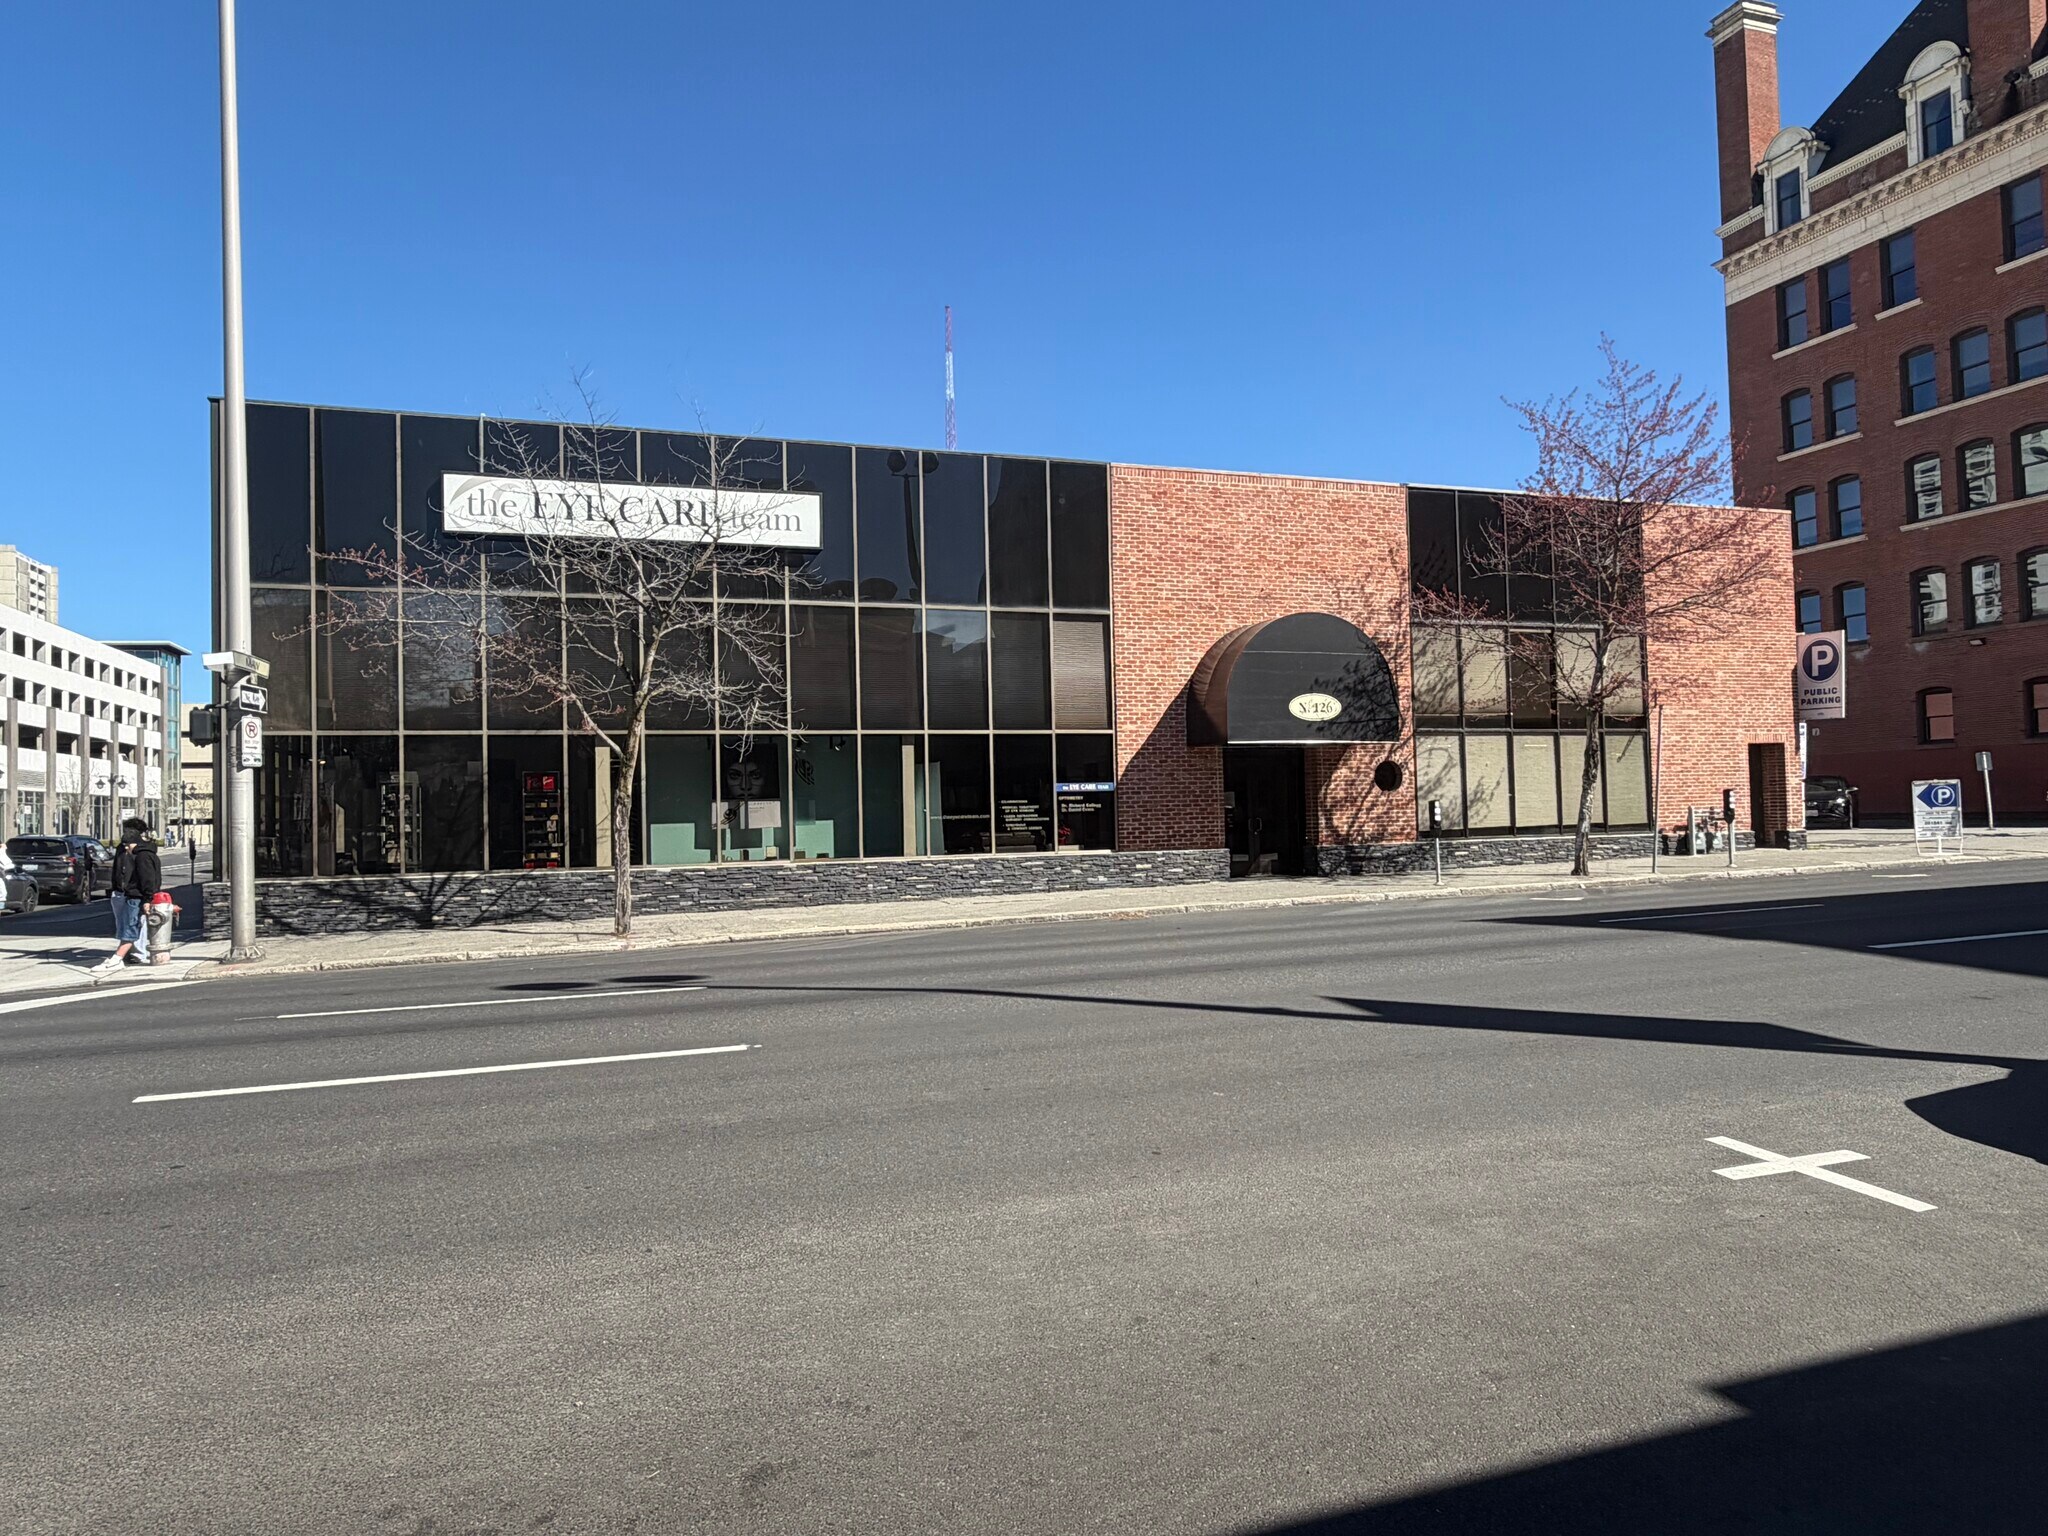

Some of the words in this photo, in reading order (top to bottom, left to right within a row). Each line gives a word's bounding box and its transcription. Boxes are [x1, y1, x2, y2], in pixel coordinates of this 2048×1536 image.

[466, 488, 518, 518] the
[532, 490, 606, 522] EYE
[728, 504, 803, 532] team
[1804, 687, 1838, 696] PUBLIC
[1801, 696, 1841, 706] PARKING
